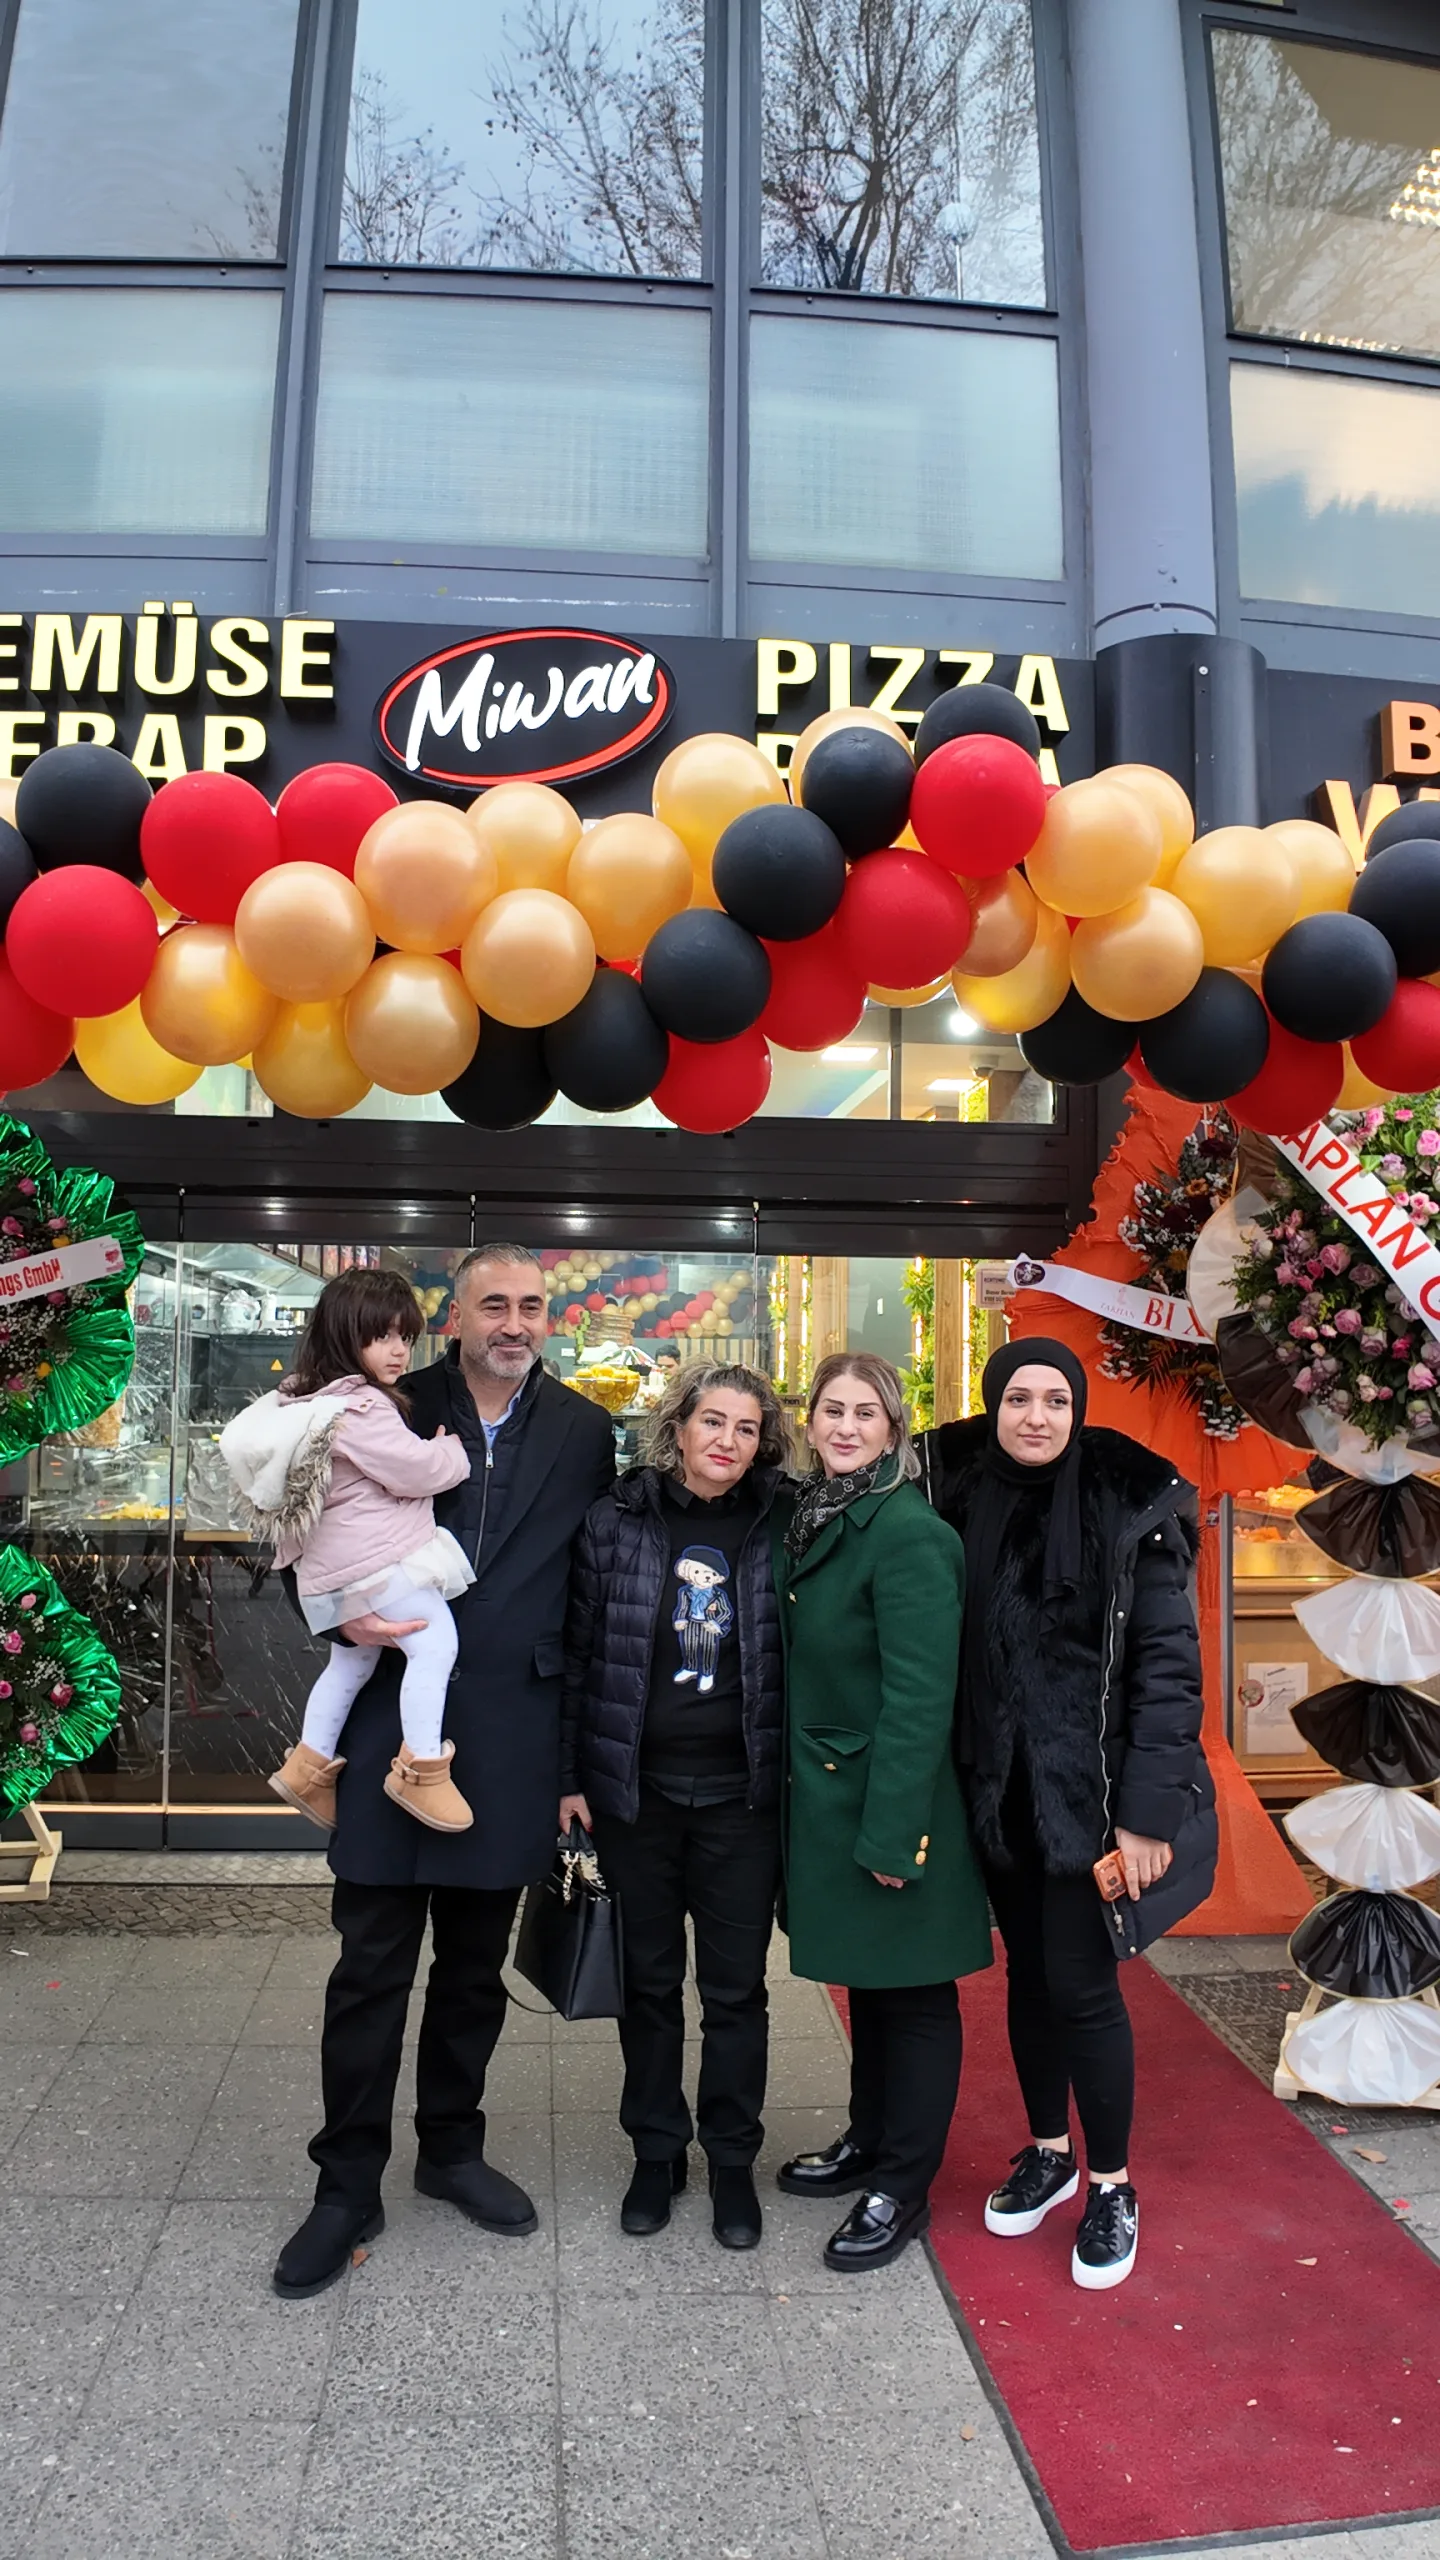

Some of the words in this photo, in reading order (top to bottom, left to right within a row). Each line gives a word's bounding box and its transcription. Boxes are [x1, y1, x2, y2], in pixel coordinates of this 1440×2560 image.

[405, 653, 656, 771] Miwan
[1277, 1123, 1430, 1270] APLAN
[23, 1258, 63, 1288] GmbH
[1143, 1297, 1175, 1332] BI
